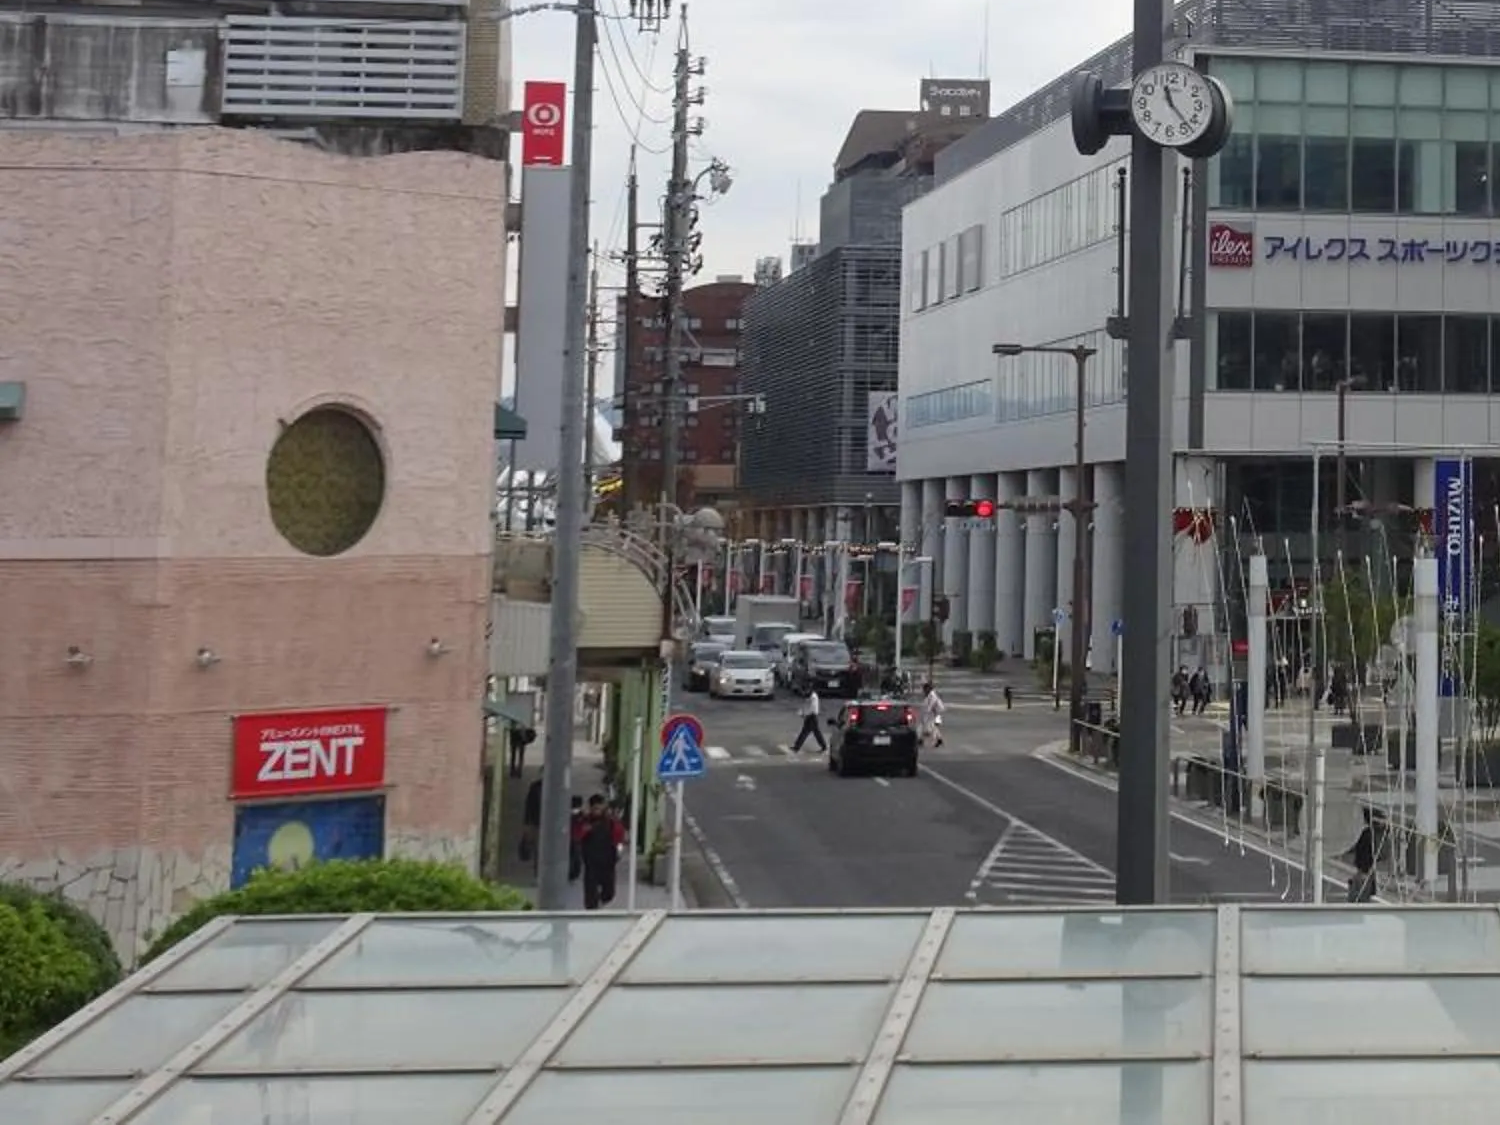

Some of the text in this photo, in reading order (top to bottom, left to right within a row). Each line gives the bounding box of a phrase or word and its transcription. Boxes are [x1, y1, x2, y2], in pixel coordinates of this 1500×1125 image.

[1211, 229, 1251, 255] ilex
[1263, 236, 1371, 261] アイレクス
[1447, 477, 1462, 555] MIZUHO
[257, 737, 365, 782] ZENT
